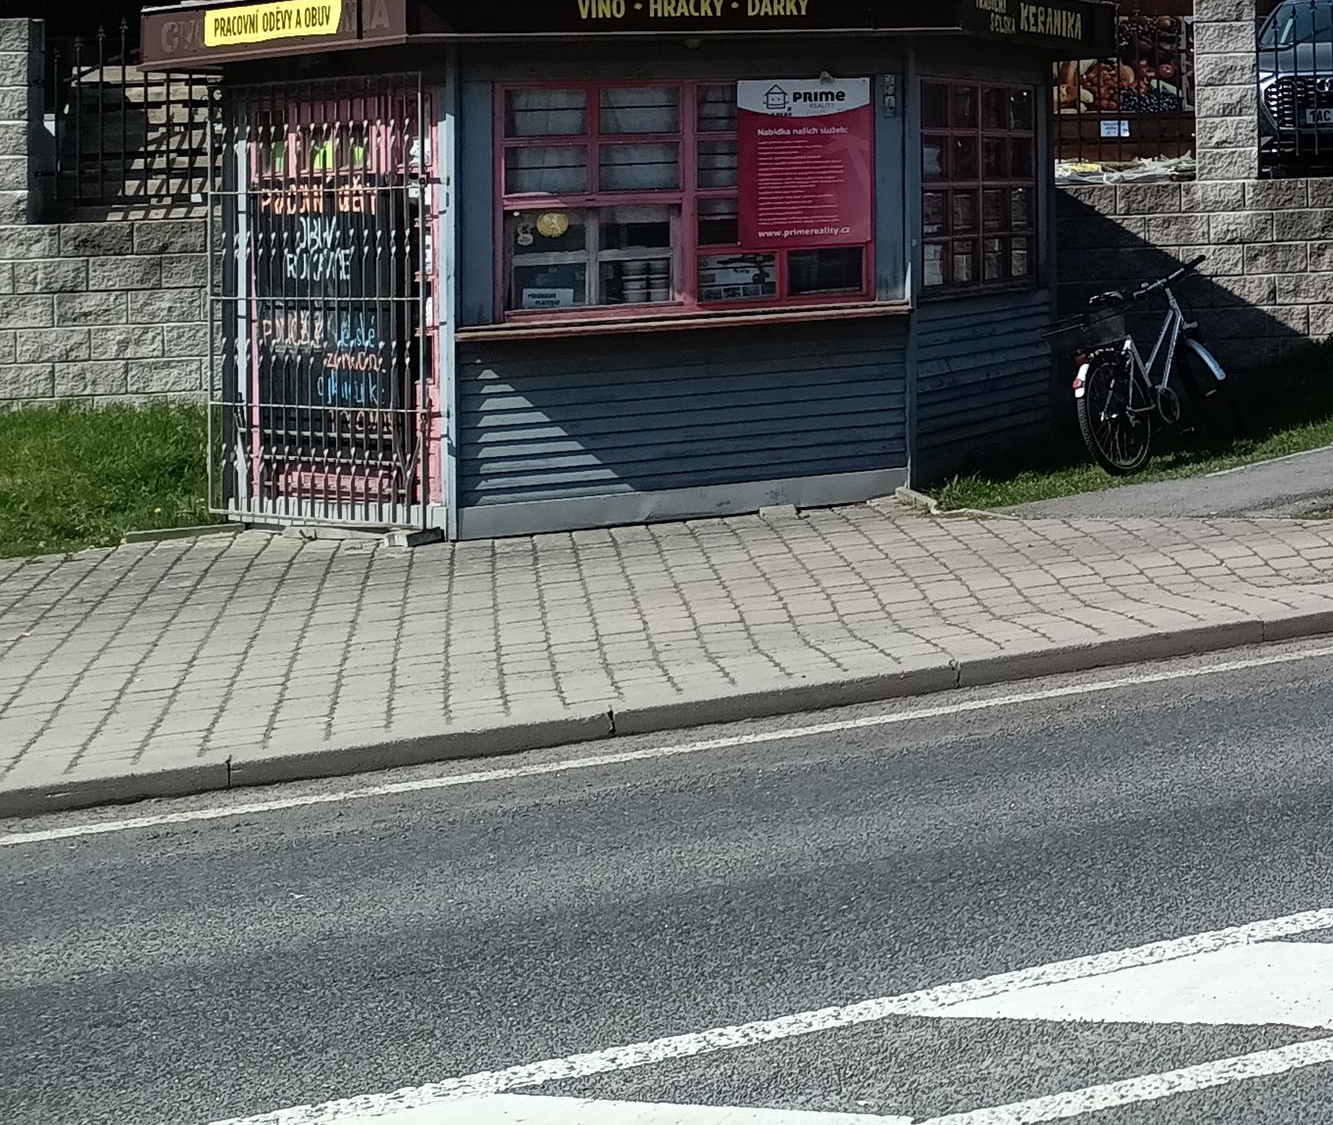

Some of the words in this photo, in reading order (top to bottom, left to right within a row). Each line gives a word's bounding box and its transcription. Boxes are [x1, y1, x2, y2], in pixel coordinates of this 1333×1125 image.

[214, 9, 260, 38] PRACOVNÍ
[262, 6, 293, 33] ODĚVY
[295, 13, 302, 29] A
[305, 5, 331, 29] OBUV
[758, 226, 851, 238] www.primereality.cz
